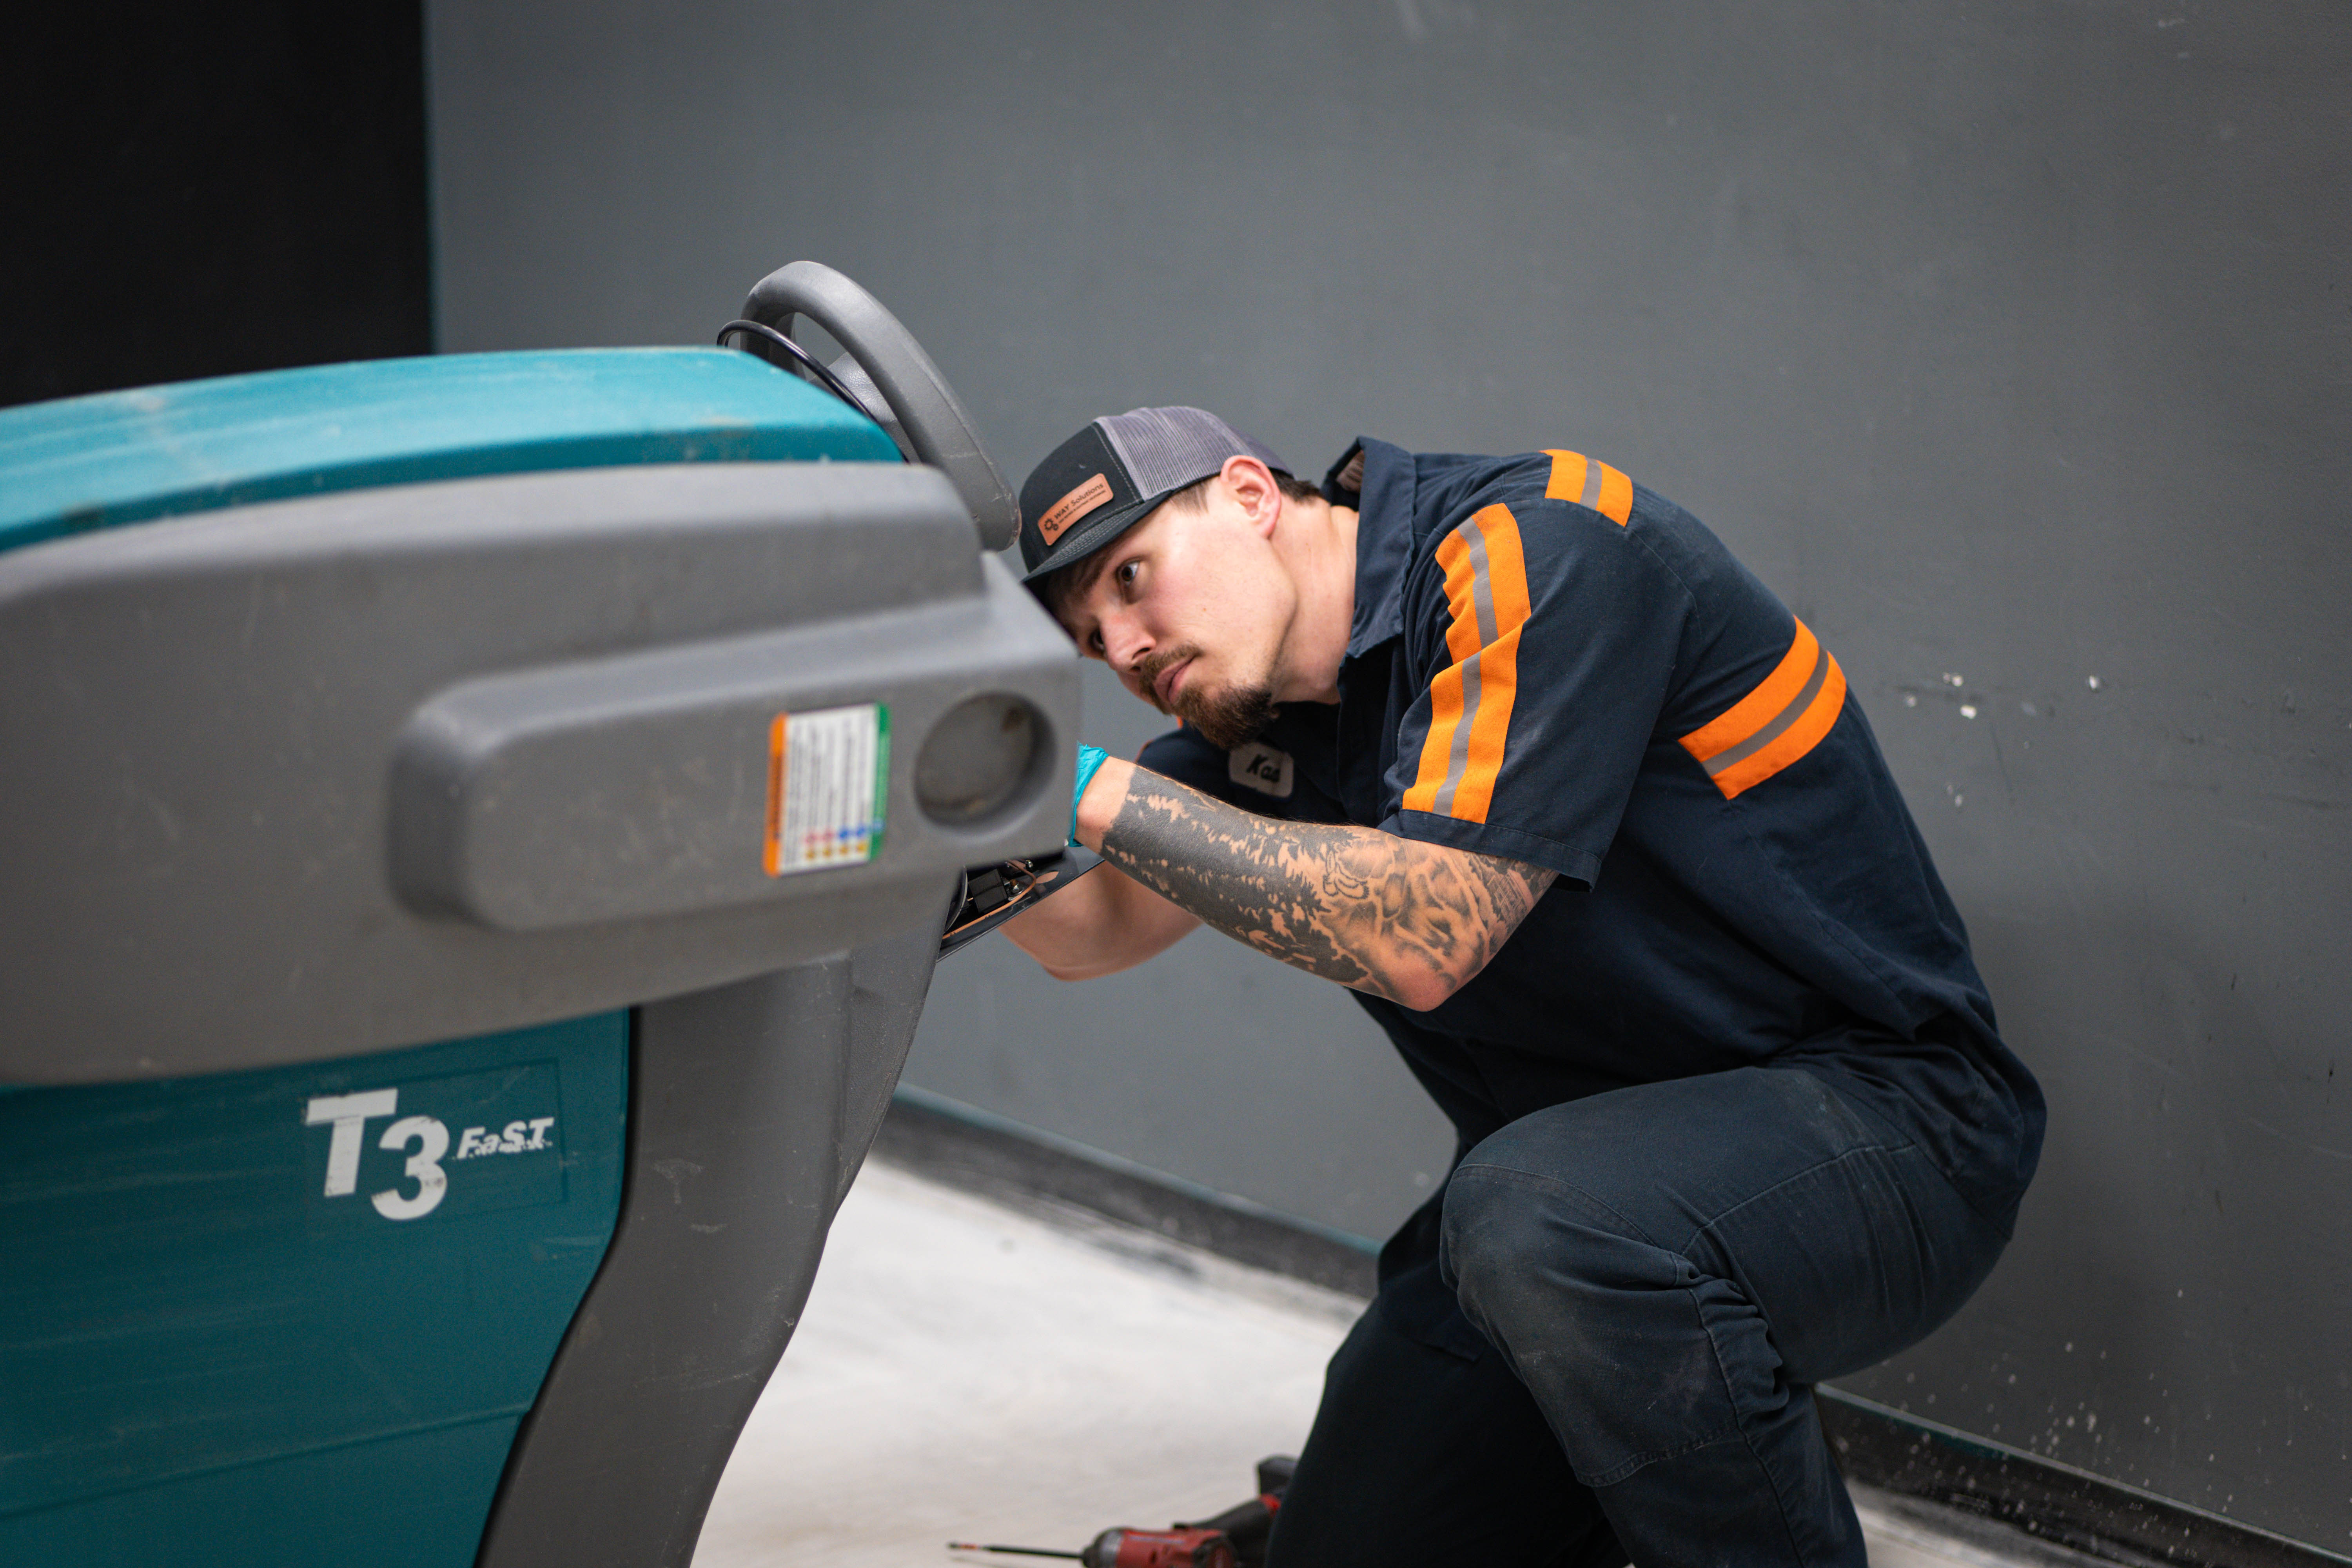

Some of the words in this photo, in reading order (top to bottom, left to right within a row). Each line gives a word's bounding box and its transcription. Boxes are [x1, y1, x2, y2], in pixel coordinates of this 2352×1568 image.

[1054, 504, 1069, 519] WAY
[1071, 484, 1103, 506] Solutions
[305, 1088, 450, 1220] T3
